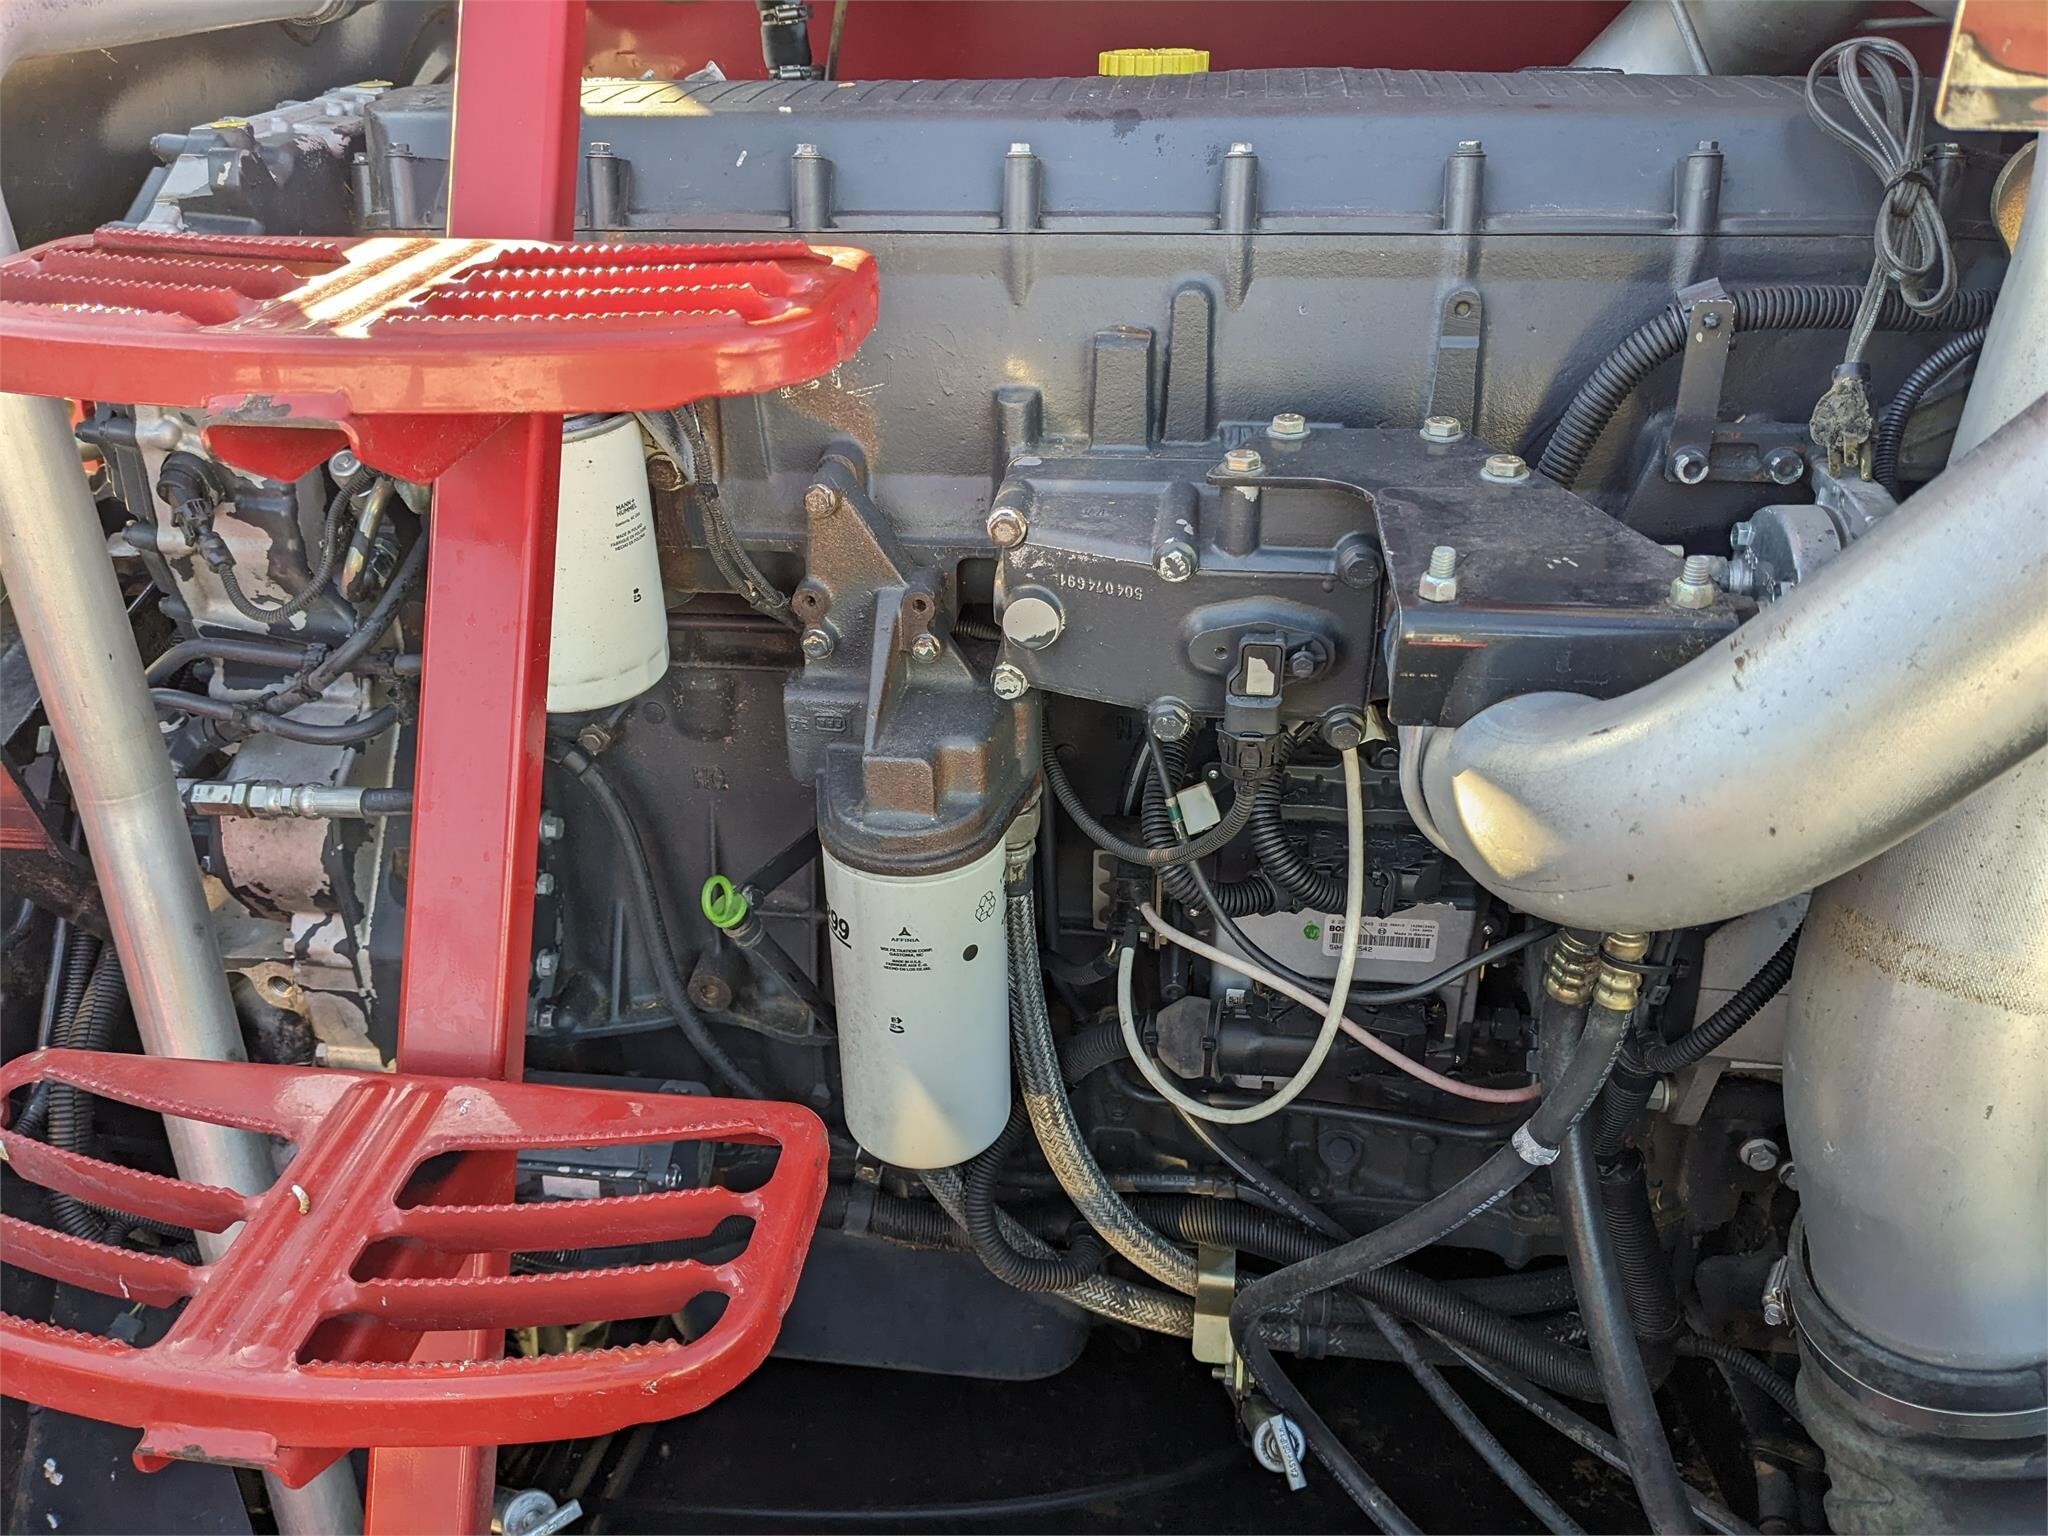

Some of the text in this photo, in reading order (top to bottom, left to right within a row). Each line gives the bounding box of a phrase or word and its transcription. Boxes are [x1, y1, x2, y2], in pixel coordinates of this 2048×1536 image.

[616, 498, 634, 511] MANN+
[617, 503, 637, 517] HUMMEL
[1060, 573, 1143, 601] 504074691
[827, 903, 849, 940] 99
